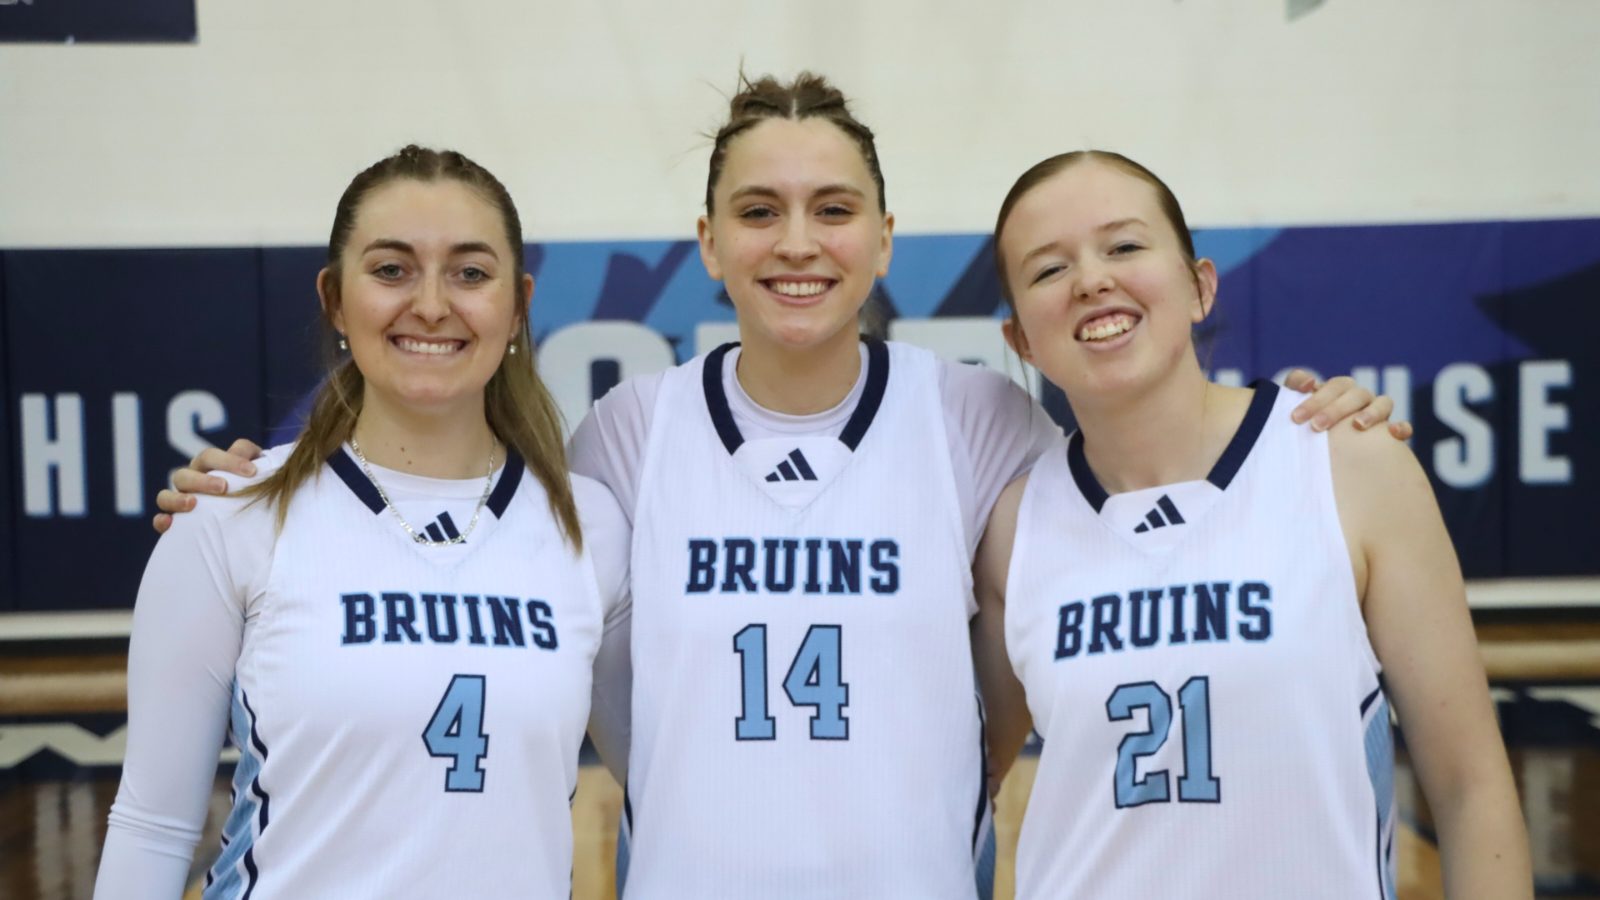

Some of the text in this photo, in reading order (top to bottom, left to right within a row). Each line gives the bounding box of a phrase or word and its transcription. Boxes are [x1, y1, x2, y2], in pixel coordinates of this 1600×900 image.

[685, 537, 902, 595] BRUINS
[340, 591, 559, 651] BRUINS
[1054, 580, 1274, 661] BRUINS
[733, 623, 850, 741] 14
[421, 673, 490, 792] 4
[1105, 675, 1221, 808] 21
